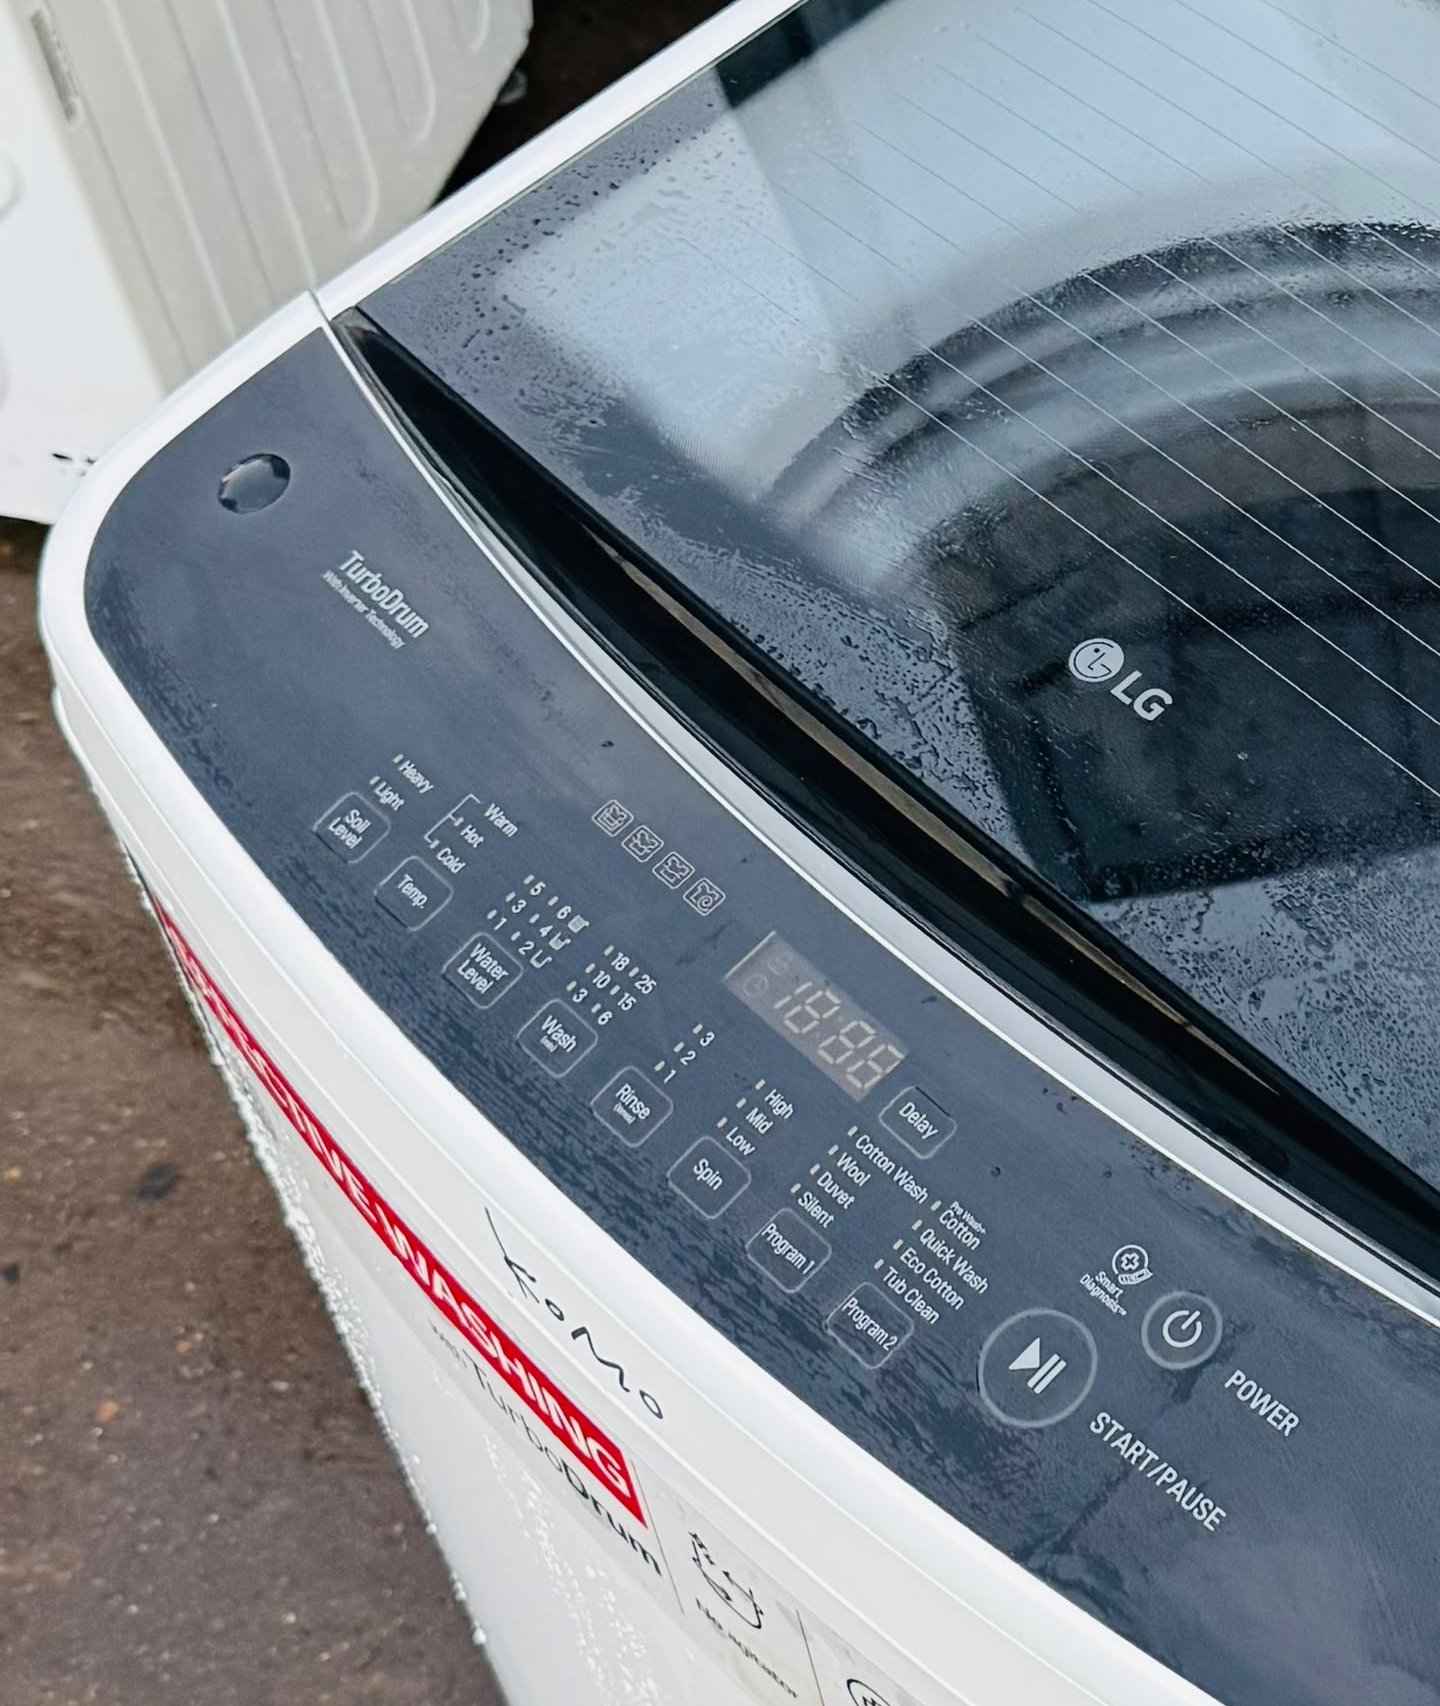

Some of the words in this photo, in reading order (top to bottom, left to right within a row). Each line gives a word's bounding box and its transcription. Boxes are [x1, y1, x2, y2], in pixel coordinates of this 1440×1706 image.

[339, 549, 429, 639] TurboDrum
[1110, 669, 1173, 721] LG
[397, 759, 435, 794] Heavy
[373, 780, 405, 812] Light
[327, 816, 363, 850] Level
[345, 808, 372, 835] Soil
[460, 823, 486, 849] Hot
[483, 802, 519, 838] Warm
[435, 846, 467, 875] Cold
[396, 873, 429, 910] Temp.
[529, 881, 547, 897] 5
[556, 905, 572, 920] 6
[493, 917, 508, 931] 1
[518, 941, 535, 955] 2
[511, 899, 527, 915] 3
[538, 924, 554, 938] 4
[456, 958, 495, 994] Level
[469, 942, 510, 983] Water
[610, 951, 631, 972] 18
[633, 973, 658, 995] 25
[572, 988, 588, 1004] 3
[597, 1010, 613, 1026] 6
[592, 969, 612, 990] 10
[616, 992, 637, 1012] 15
[540, 1015, 577, 1053] Wash
[699, 1031, 716, 1048] 3
[663, 1069, 677, 1084] 1
[680, 1050, 697, 1066] 2
[615, 1082, 651, 1120] Rinse
[763, 1087, 795, 1121] High
[744, 1106, 774, 1135] Mid
[898, 1101, 939, 1141] Delay
[724, 1126, 757, 1157] Low
[693, 1157, 724, 1192] Spin
[836, 1151, 871, 1187] Wool
[855, 1133, 896, 1176] Cotton
[892, 1166, 929, 1205] Wash
[816, 1170, 856, 1210] Duvet
[797, 1190, 835, 1229] Silent
[760, 1222, 810, 1270] Program
[802, 1259, 816, 1275] 1
[939, 1209, 981, 1250] Cotton
[900, 1246, 926, 1274] Eco
[922, 1267, 965, 1311] Cotton
[919, 1228, 956, 1266] Quick
[951, 1256, 989, 1295] Wash
[882, 1266, 908, 1295] Tub
[903, 1287, 941, 1325] Clean
[1095, 1271, 1124, 1298] Smart
[841, 1296, 890, 1346] Program
[375, 1201, 632, 1499] WASHING
[1223, 1368, 1301, 1437] POWER
[461, 1348, 662, 1577] TurboDrum
[1089, 1411, 1228, 1532] START/PAUSE
